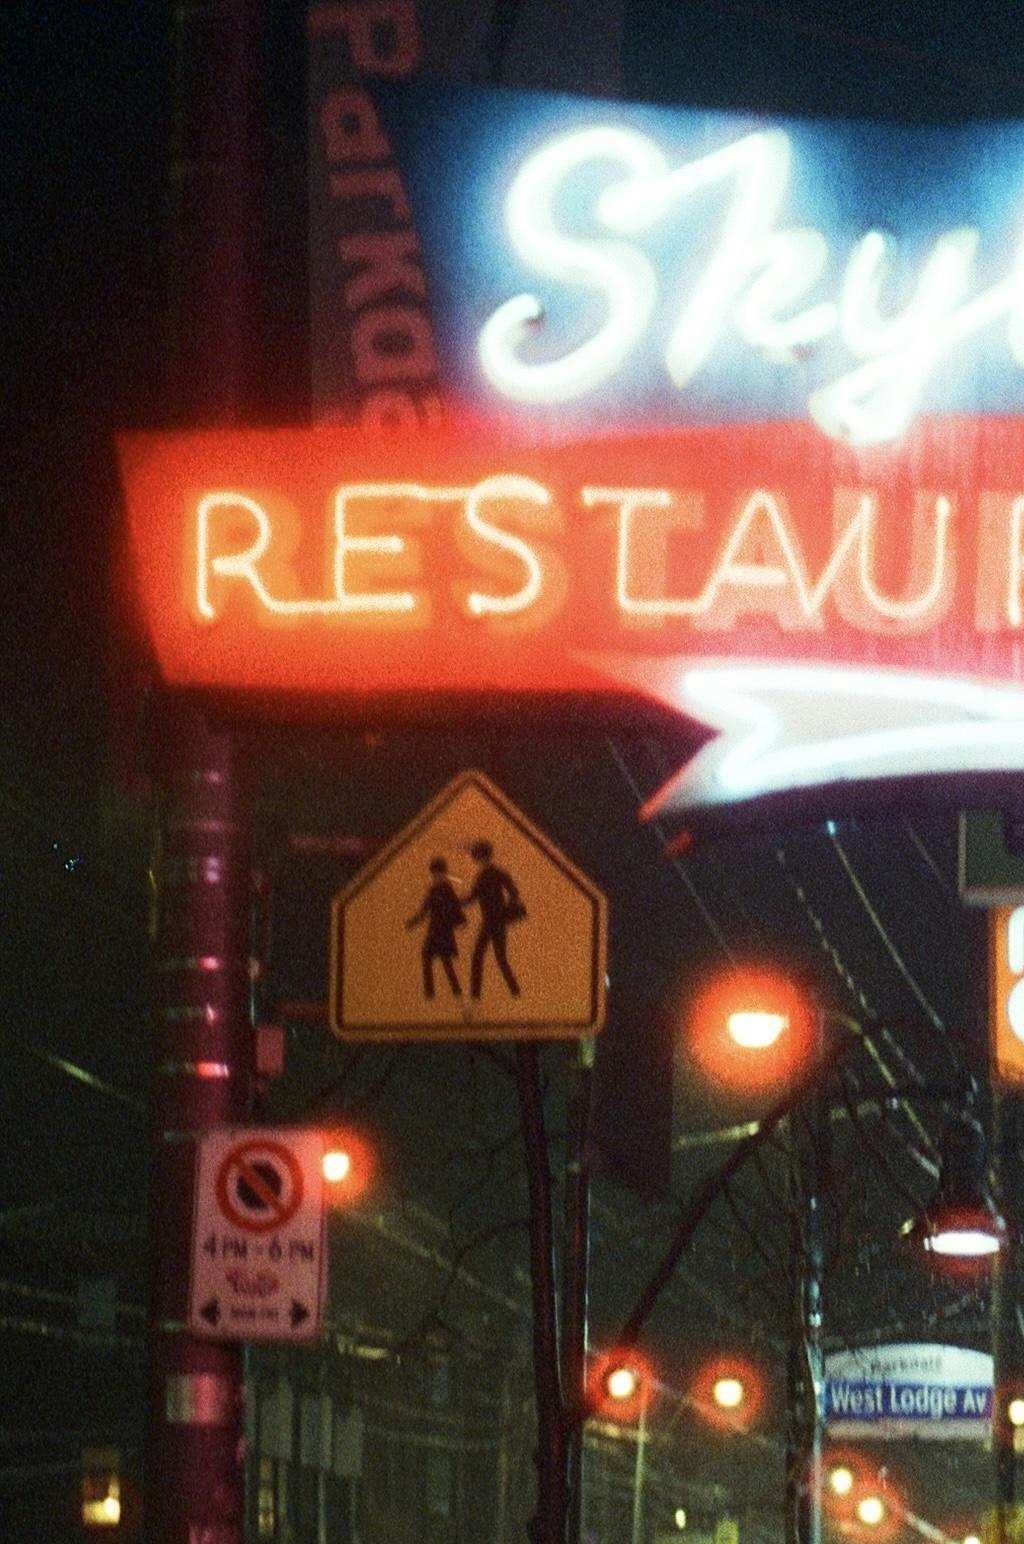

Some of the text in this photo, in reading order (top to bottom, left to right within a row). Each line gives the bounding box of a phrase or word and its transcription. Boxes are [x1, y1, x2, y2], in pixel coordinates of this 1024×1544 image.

[830, 1382, 987, 1420] West Lodge Av
